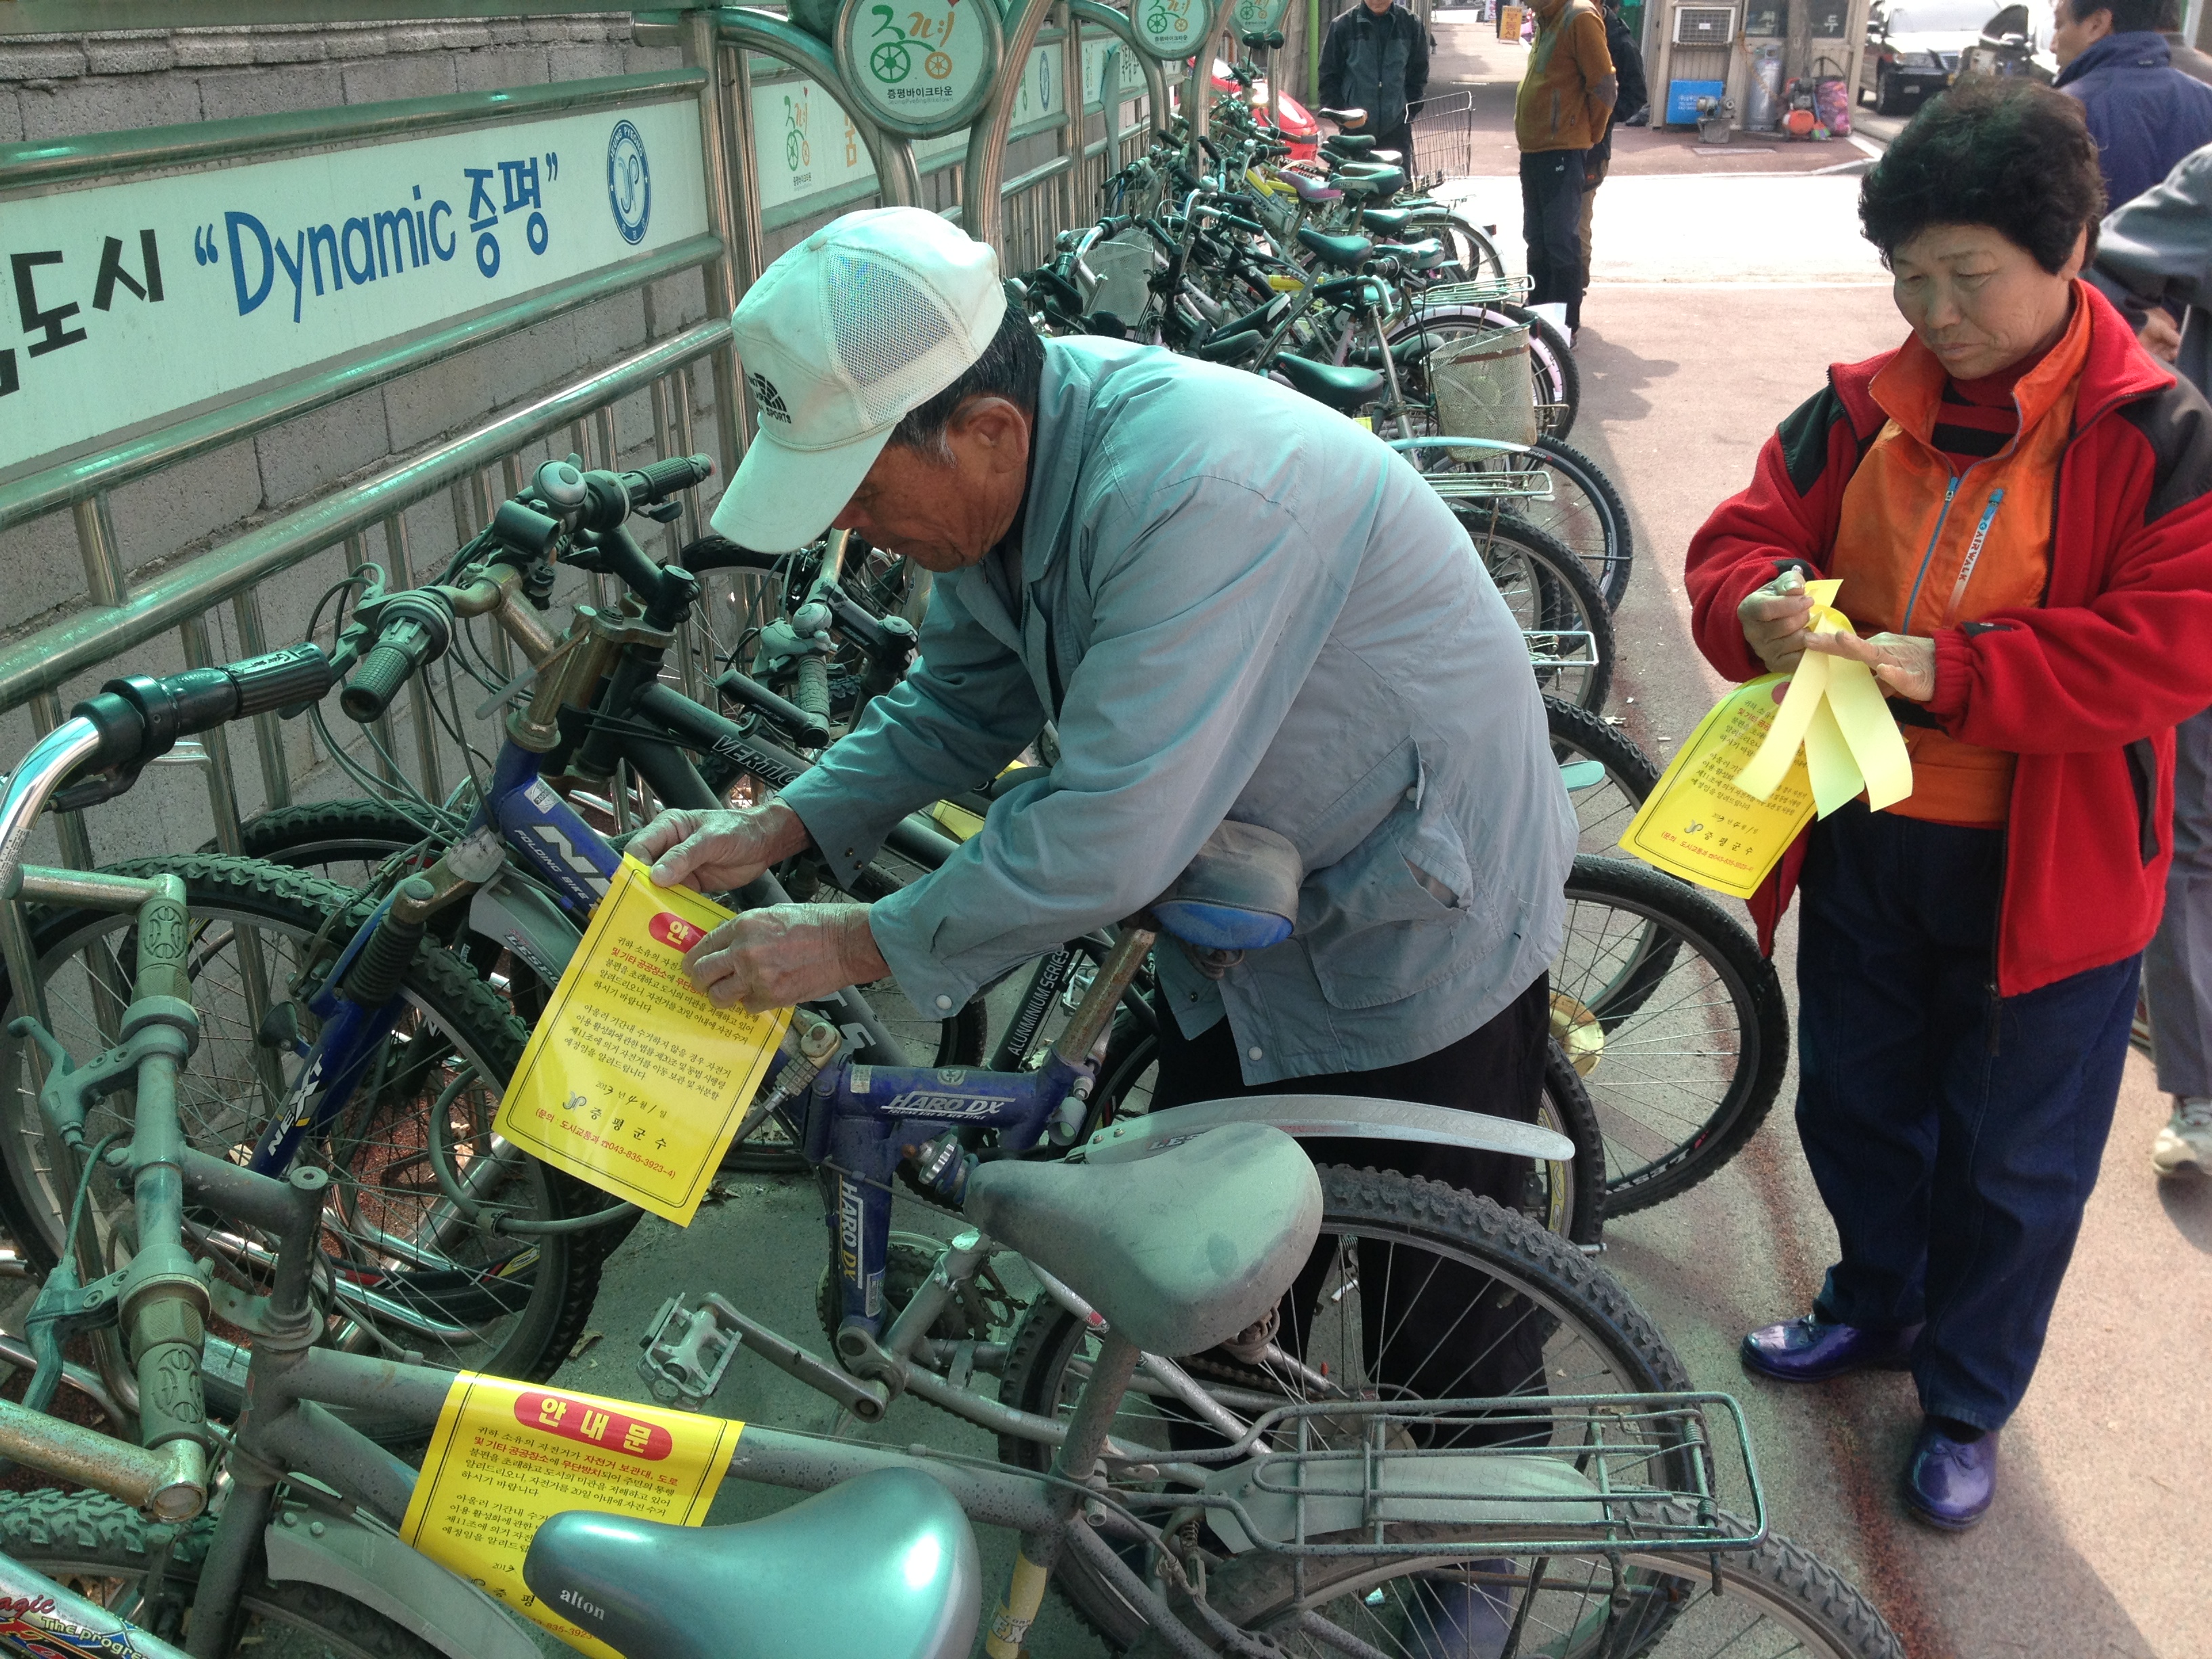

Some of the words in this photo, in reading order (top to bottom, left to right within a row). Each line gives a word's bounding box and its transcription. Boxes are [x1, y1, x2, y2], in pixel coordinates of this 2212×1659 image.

[887, 86, 953, 99] 증평바이크타운
[766, 407, 792, 424] SPORTS
[1959, 531, 1984, 581] AIRWALK
[514, 830, 562, 873] FOLDING
[561, 876, 590, 900] BIKE
[1040, 950, 1069, 989] SERIES
[592, 979, 619, 998] 하시기
[582, 1002, 609, 1021] 아울러
[609, 1015, 636, 1033] 기간내
[636, 1027, 670, 1050] 수거하지
[669, 1043, 688, 1059] 않을
[688, 1052, 705, 1066] 경우
[705, 1060, 731, 1079] 자전거
[888, 1094, 964, 1111] HARO
[966, 1099, 1004, 1114] DX
[842, 1181, 859, 1248] HARO
[842, 1249, 857, 1282] DX
[473, 1437, 484, 1446] 및
[485, 1439, 508, 1452] 기타
[508, 1446, 560, 1466] 공공장소에
[560, 1460, 621, 1482] 무단방치되어
[623, 1476, 653, 1490] 주민의
[654, 1484, 675, 1496] 통행
[476, 1425, 499, 1437] 귀하
[501, 1432, 535, 1447] 소유의
[537, 1441, 581, 1460] 자전거가
[583, 1454, 616, 1469] 자전거
[657, 1474, 678, 1486] 도로
[459, 1470, 493, 1485] 하시기
[468, 1448, 500, 1462] 불편을
[501, 1456, 543, 1474] 초래하고
[544, 1467, 575, 1482] 도시의
[575, 1476, 607, 1491] 미관을
[608, 1485, 649, 1501] 저해하고
[650, 1496, 671, 1507] 있어
[454, 1494, 489, 1509] 아울러
[491, 1502, 524, 1517] 기간내
[526, 1511, 549, 1523] 수거
[527, 1475, 570, 1492] 자전거를
[570, 1486, 592, 1498] 20일
[592, 1492, 623, 1507] 이내에
[623, 1500, 644, 1512] 자진
[645, 1505, 666, 1517] 수거
[444, 1515, 488, 1532] 제11조에
[489, 1525, 511, 1537] 의거
[511, 1530, 533, 1542] 자전
[448, 1503, 472, 1515] 이용
[471, 1509, 512, 1525] 활성화에
[512, 1518, 533, 1530] 관한
[440, 1525, 485, 1542] 예정임을
[485, 1536, 530, 1553] 알려드립
[559, 1589, 605, 1620] alton
[41, 1616, 77, 1635] The
[79, 1628, 150, 1659] progre
